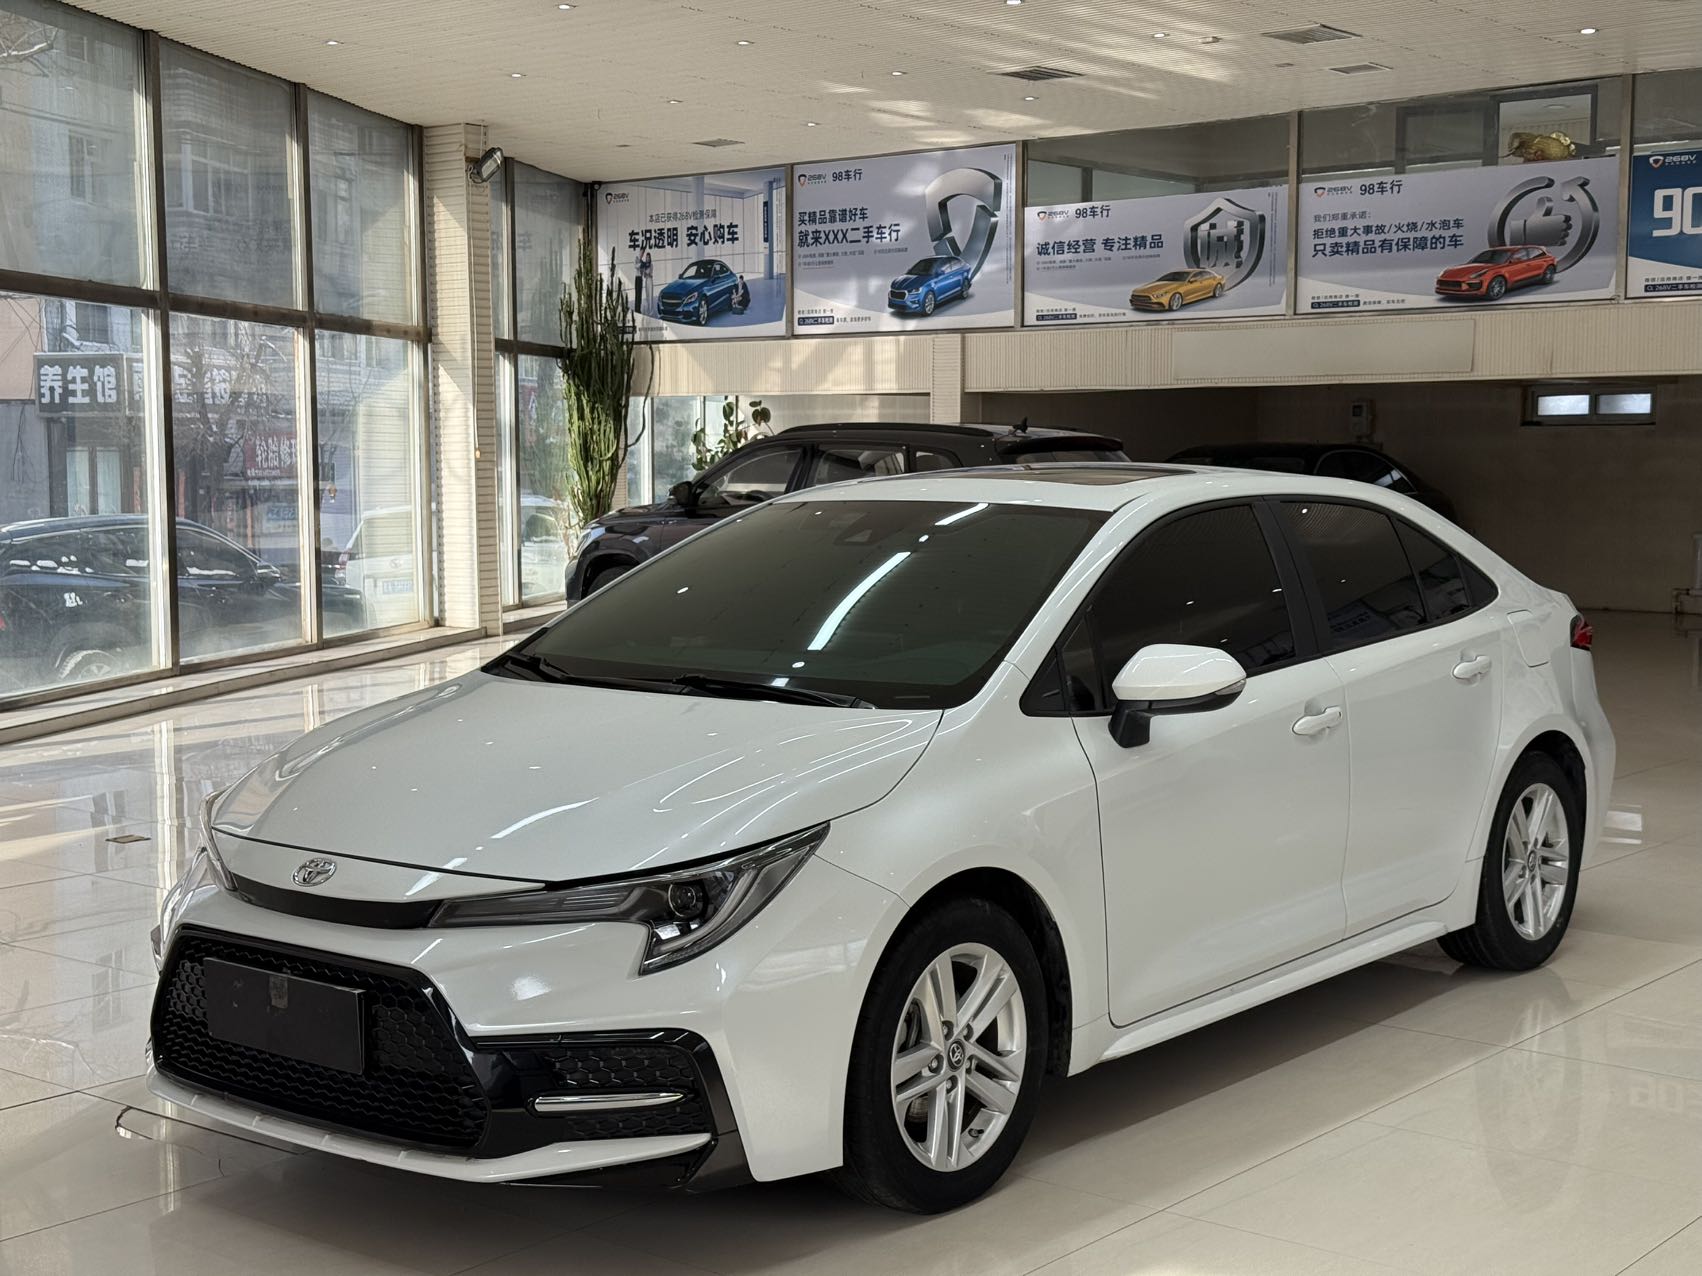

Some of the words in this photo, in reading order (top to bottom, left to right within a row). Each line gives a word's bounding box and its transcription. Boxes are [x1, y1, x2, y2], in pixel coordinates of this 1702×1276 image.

[832, 168, 863, 182] 98车行
[1359, 179, 1403, 196] 98车行
[797, 206, 869, 227] 买精品靠谱好车
[1075, 204, 1111, 219] 98车行
[628, 227, 679, 251] 车况透明
[685, 222, 739, 248] 安心购车
[797, 223, 901, 249] 就来XXX二手车行
[1312, 218, 1464, 241] 拒绝重大事故/火烧/水泡车
[1036, 238, 1097, 257] 诚信经营
[1101, 233, 1164, 253] 专注精品
[1312, 233, 1464, 258] 只卖精品有保障的车
[39, 364, 118, 404] 养生馆
